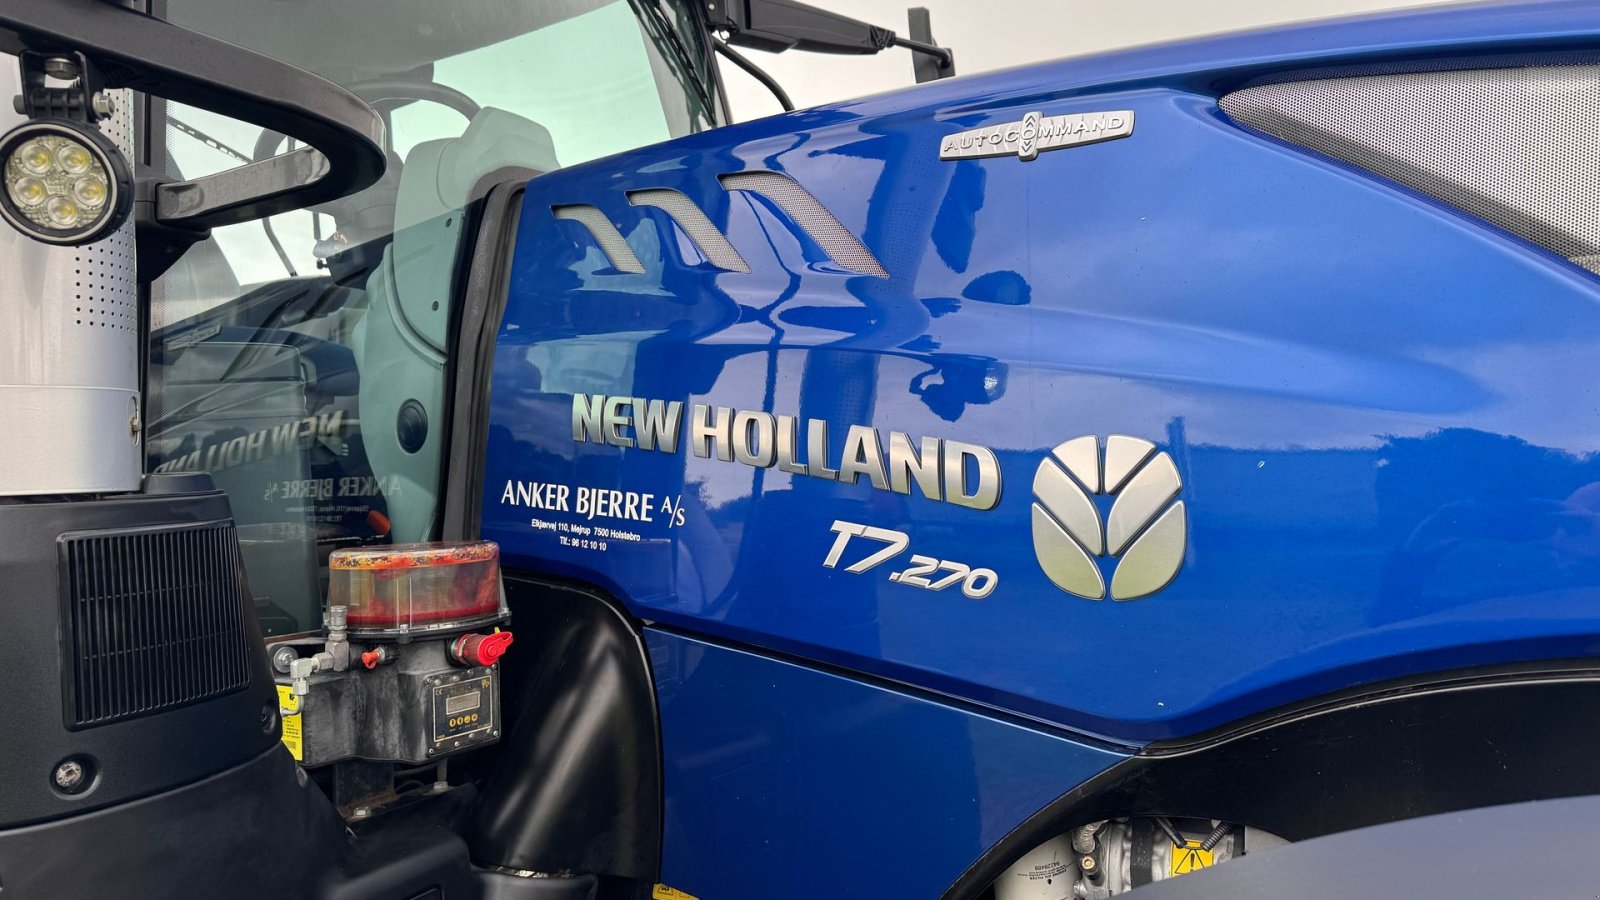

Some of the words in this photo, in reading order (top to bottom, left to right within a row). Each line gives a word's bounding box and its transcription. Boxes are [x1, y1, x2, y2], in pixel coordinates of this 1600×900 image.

[943, 117, 1124, 152] AUTOCOMMAND
[571, 393, 683, 454] NEW
[692, 404, 1002, 511] HOLLAND
[501, 479, 569, 512] ANKER
[575, 487, 654, 521] BJERRE
[661, 495, 686, 528] A/S
[531, 518, 557, 532] Elkjærvej
[558, 522, 570, 533] 110,
[570, 524, 591, 536] Mejrup
[594, 526, 610, 538] 7500
[610, 528, 641, 542] Holstebro
[571, 537, 580, 547] 96
[581, 539, 589, 549] 12
[590, 540, 598, 550] 10
[599, 541, 607, 551] 10
